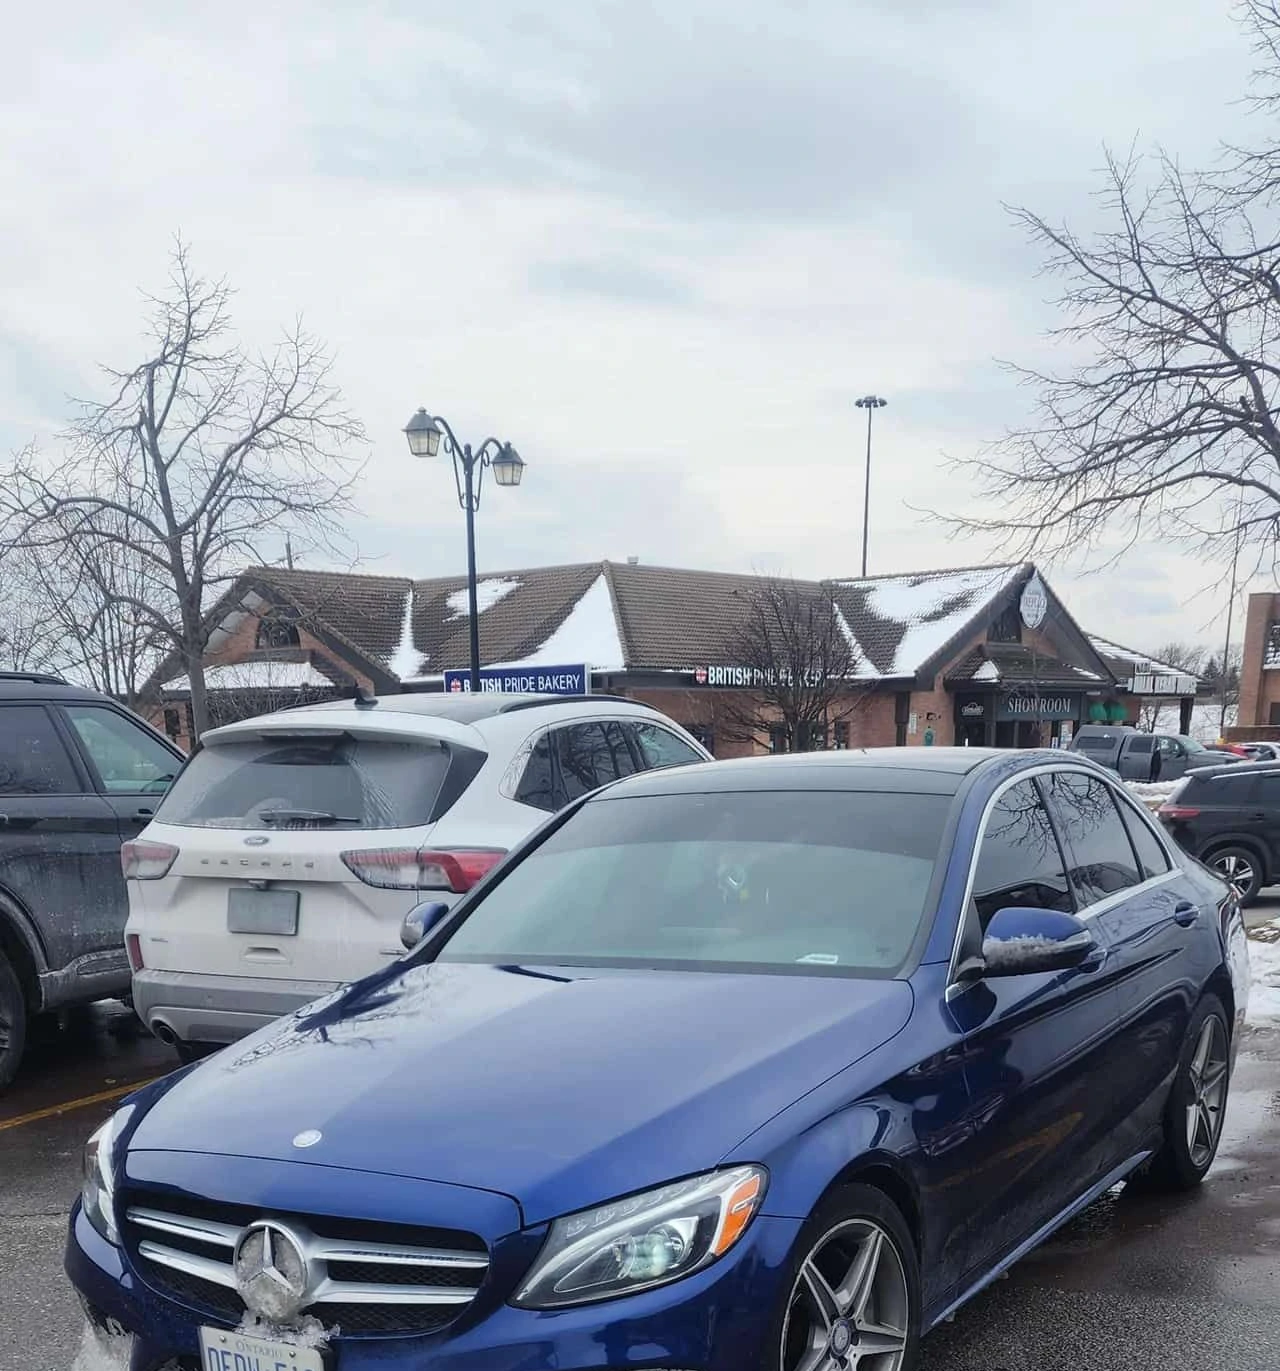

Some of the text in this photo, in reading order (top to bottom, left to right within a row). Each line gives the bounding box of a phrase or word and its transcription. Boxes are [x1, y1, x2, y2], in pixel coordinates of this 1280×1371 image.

[463, 674, 581, 692] BTISH PRIDE BAKERY
[708, 666, 750, 685] BRITISH
[1007, 698, 1072, 713] SHOWROOM
